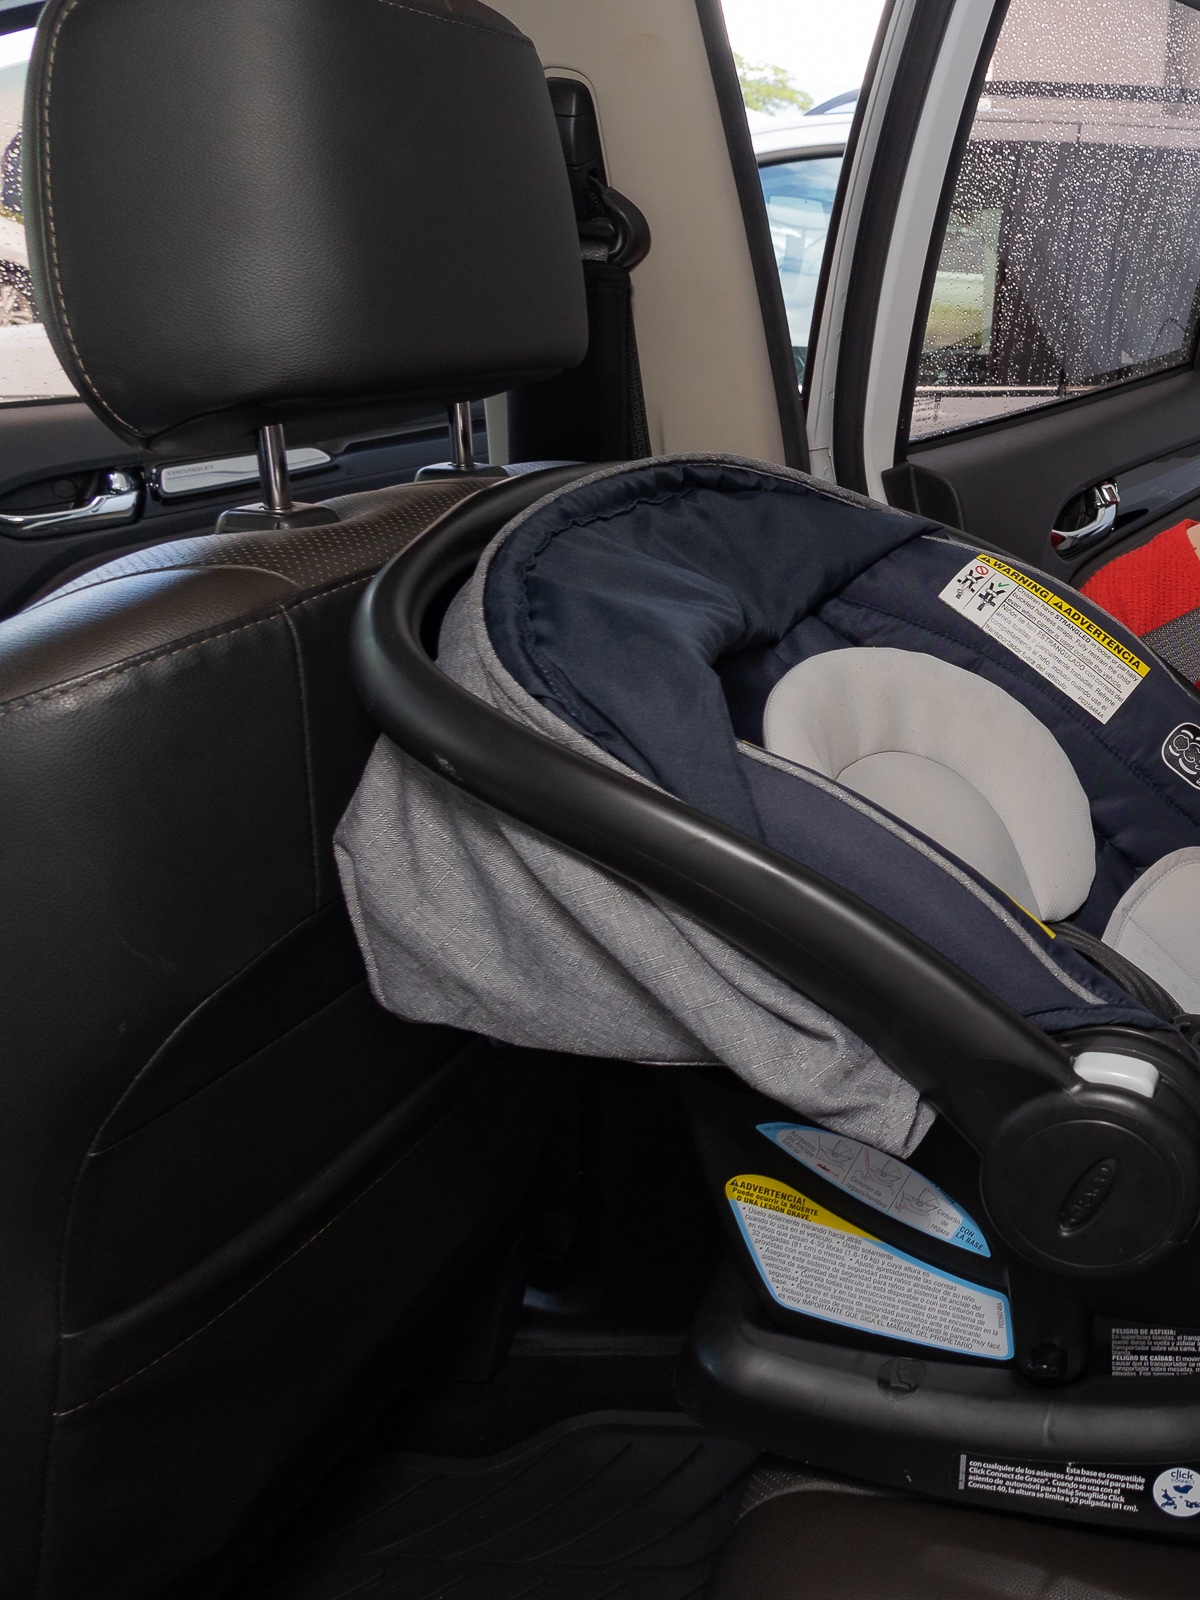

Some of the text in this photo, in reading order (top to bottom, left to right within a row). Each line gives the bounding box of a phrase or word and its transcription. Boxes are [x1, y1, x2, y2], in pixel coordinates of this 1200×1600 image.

[992, 561, 1050, 600] WARNING
[1007, 598, 1022, 611] even
[1021, 608, 1037, 622] when
[1036, 620, 1055, 636] carrier
[1059, 638, 1074, 651] used
[1073, 648, 1094, 667] outside
[1093, 664, 1104, 674] the
[1102, 671, 1124, 690] vehicle.
[1012, 591, 1131, 685] buckled harness straps. Fully restrain the child
[1017, 587, 1041, 607] Children
[1040, 604, 1055, 617] have
[1054, 614, 1091, 645] STRANGLED
[1096, 646, 1112, 661] loose
[1116, 662, 1140, 683] partially
[1063, 606, 1142, 670] ADVERTENCIA
[1001, 604, 1125, 703] Niños se han ESTRANGULADO con correas del
[732, 1187, 755, 1198] Puede
[755, 1194, 779, 1205] ocurrir
[789, 1203, 819, 1216] MUERTE
[740, 1181, 806, 1206] ADVERTENCIA!
[743, 1197, 759, 1206] UNA
[760, 1202, 786, 1214] LESIÓN
[745, 1214, 769, 1225] cuando
[806, 1231, 834, 1244] vehículo.
[842, 1240, 861, 1251] Úselo
[861, 1247, 894, 1261] solamente
[748, 1206, 862, 1245] Úselo solamente mirando hacia atrás
[959, 1226, 975, 1237] CON
[955, 1232, 983, 1251] LA BASE
[969, 1467, 985, 1475] Click
[986, 1470, 1014, 1479] Connect
[1052, 1479, 1078, 1488] Cuando
[969, 1474, 993, 1483] asiento
[1005, 1479, 1040, 1490] automóvil
[1041, 1485, 1056, 1494] para
[1057, 1487, 1074, 1495] bebé
[1075, 1490, 1107, 1501] SnugRide
[1109, 1494, 1125, 1502] Click
[983, 1462, 1015, 1473] cualquier
[1036, 1470, 1064, 1479] asientos
[1074, 1475, 1109, 1486] automóvil
[1110, 1480, 1125, 1489] para
[1126, 1483, 1144, 1491] bebé
[1081, 1469, 1097, 1477] base
[1107, 1473, 1145, 1485] compatible
[968, 1481, 996, 1491] Connect
[997, 1485, 1008, 1494] 40,
[1016, 1488, 1036, 1497] altura
[1045, 1492, 1064, 1501] limita
[1079, 1498, 1110, 1509] pulgadas
[1112, 1502, 1122, 1511] (81
